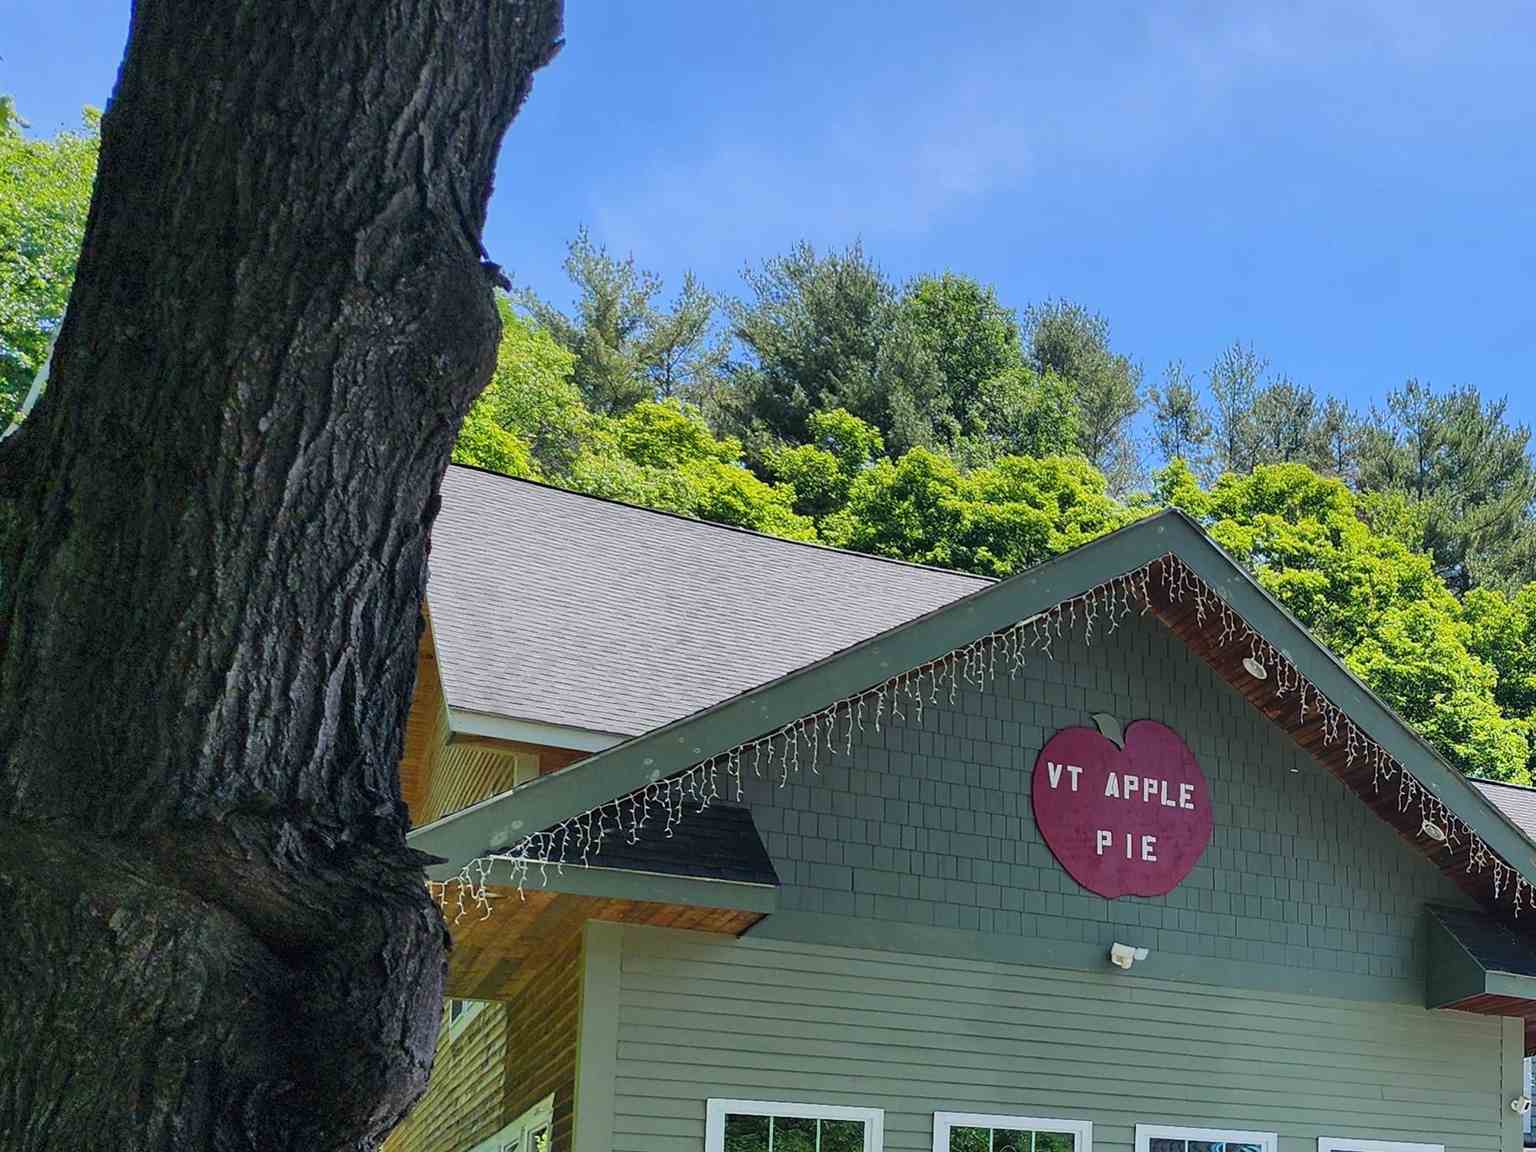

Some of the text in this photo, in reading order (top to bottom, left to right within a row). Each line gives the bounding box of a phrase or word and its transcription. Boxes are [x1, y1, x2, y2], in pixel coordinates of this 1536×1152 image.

[1047, 762, 1194, 809] VT APPLE
[1097, 830, 1157, 861] PIE
